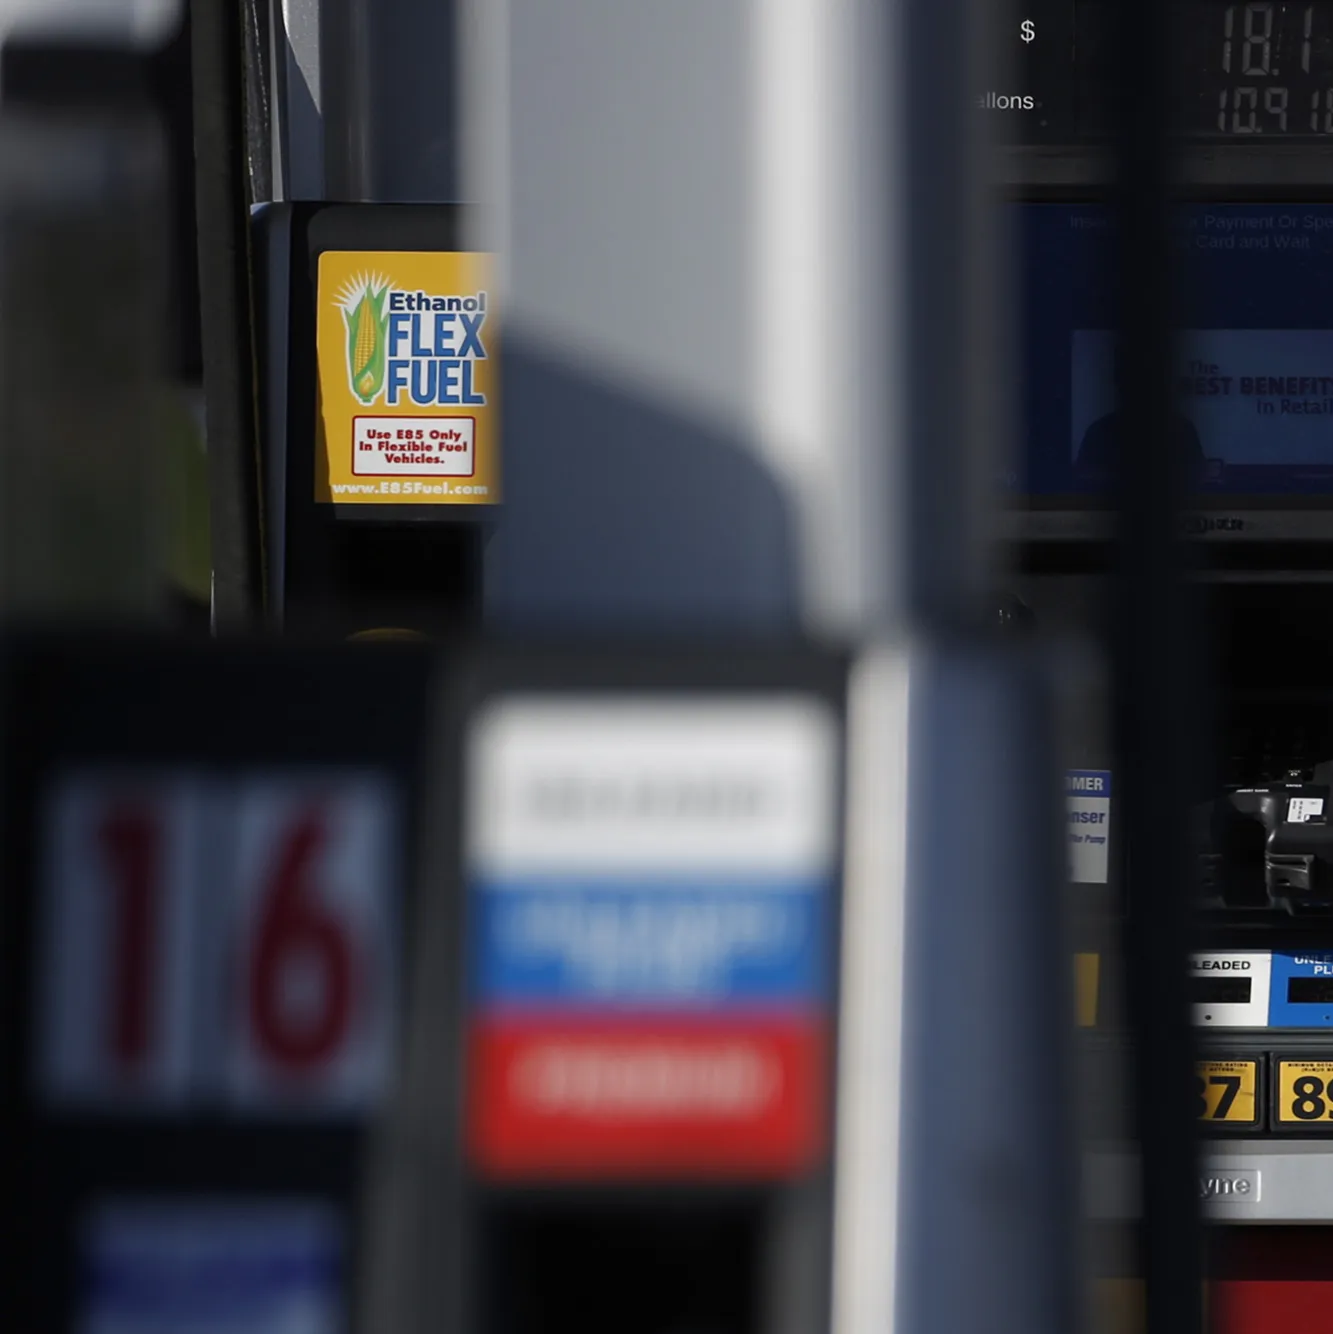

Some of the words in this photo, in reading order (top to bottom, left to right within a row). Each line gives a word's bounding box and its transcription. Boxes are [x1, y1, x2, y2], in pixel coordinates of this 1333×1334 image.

[1019, 18, 1036, 44] $
[389, 293, 486, 312] Ethanol
[388, 313, 487, 358] FLEX
[387, 360, 486, 405] FUEL
[366, 429, 391, 440] Use
[397, 429, 424, 440] E85
[429, 429, 461, 443] Only
[359, 441, 374, 452] In
[378, 440, 433, 452] Flexible
[438, 441, 468, 452] Fuel
[384, 453, 445, 465] Vehicles.
[332, 481, 488, 496] www.E85Fuel.com
[95, 795, 360, 1075] 16
